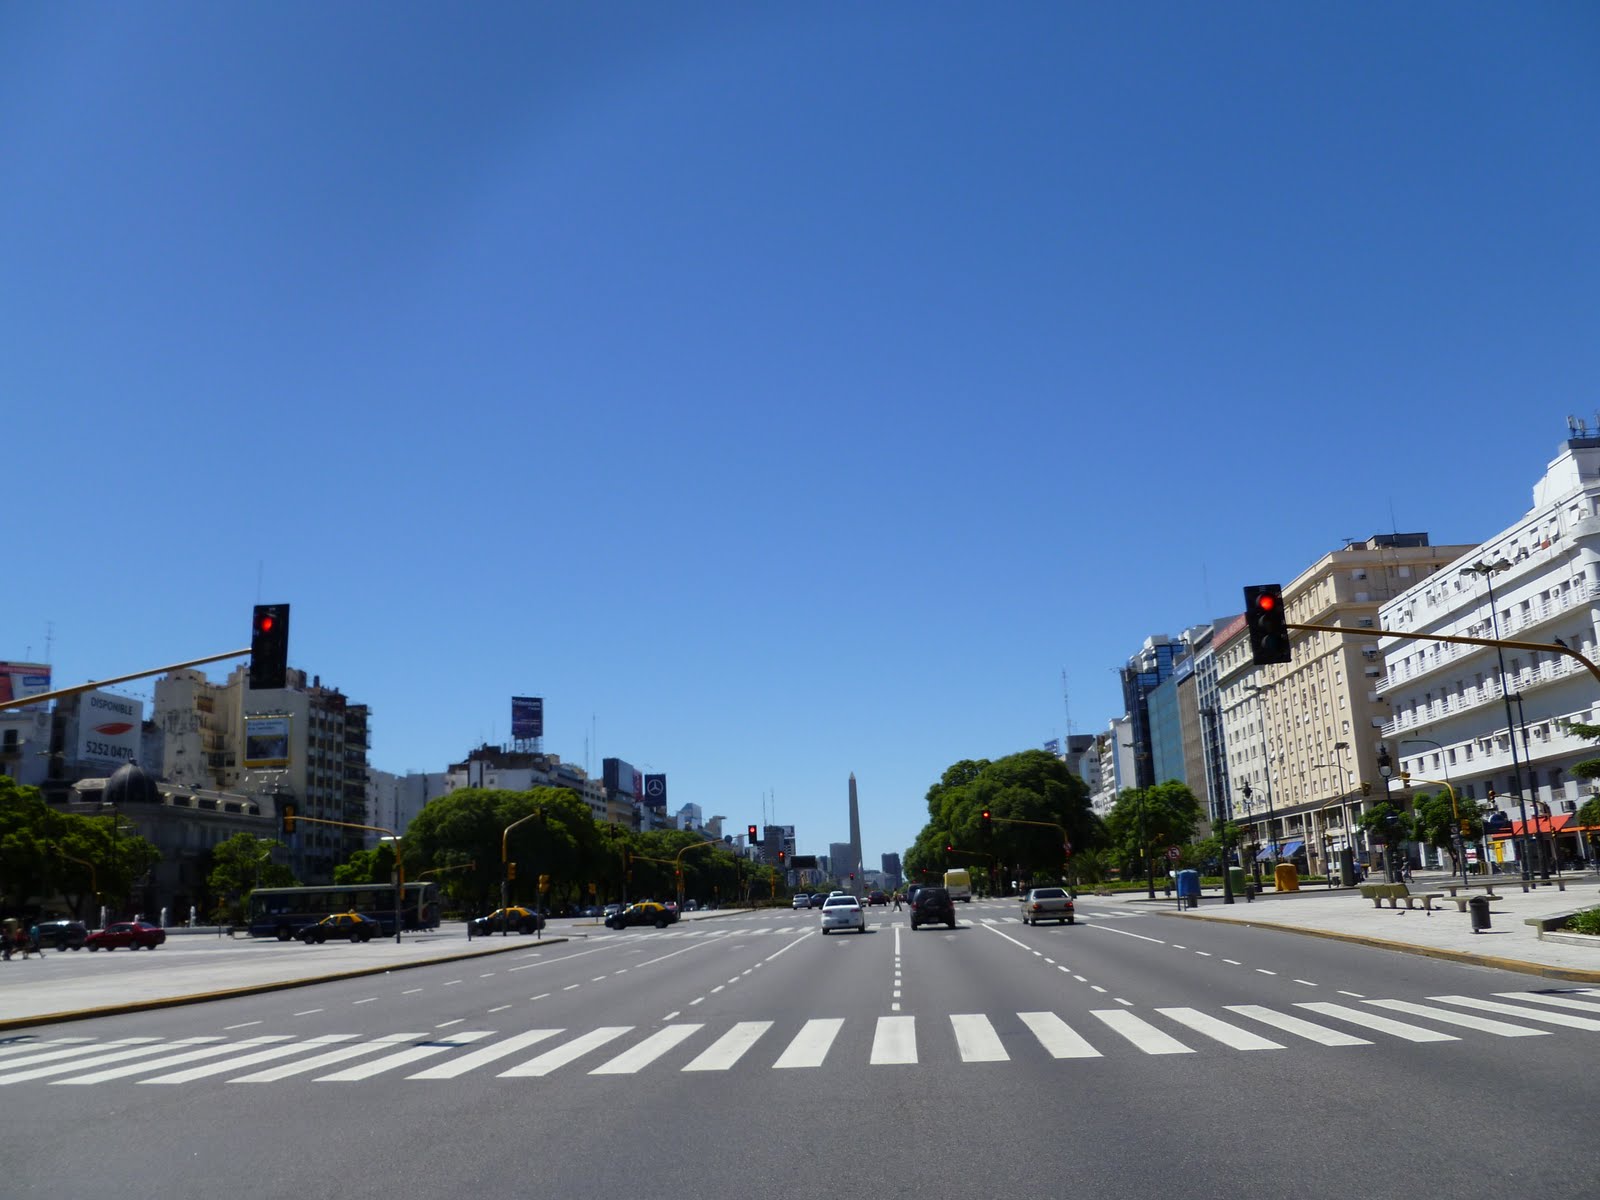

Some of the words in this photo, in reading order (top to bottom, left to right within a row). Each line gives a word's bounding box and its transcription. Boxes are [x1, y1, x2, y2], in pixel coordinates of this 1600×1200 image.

[91, 697, 133, 716] DISPONIBLE
[86, 741, 109, 756] 5252
[110, 745, 133, 760] 0470
